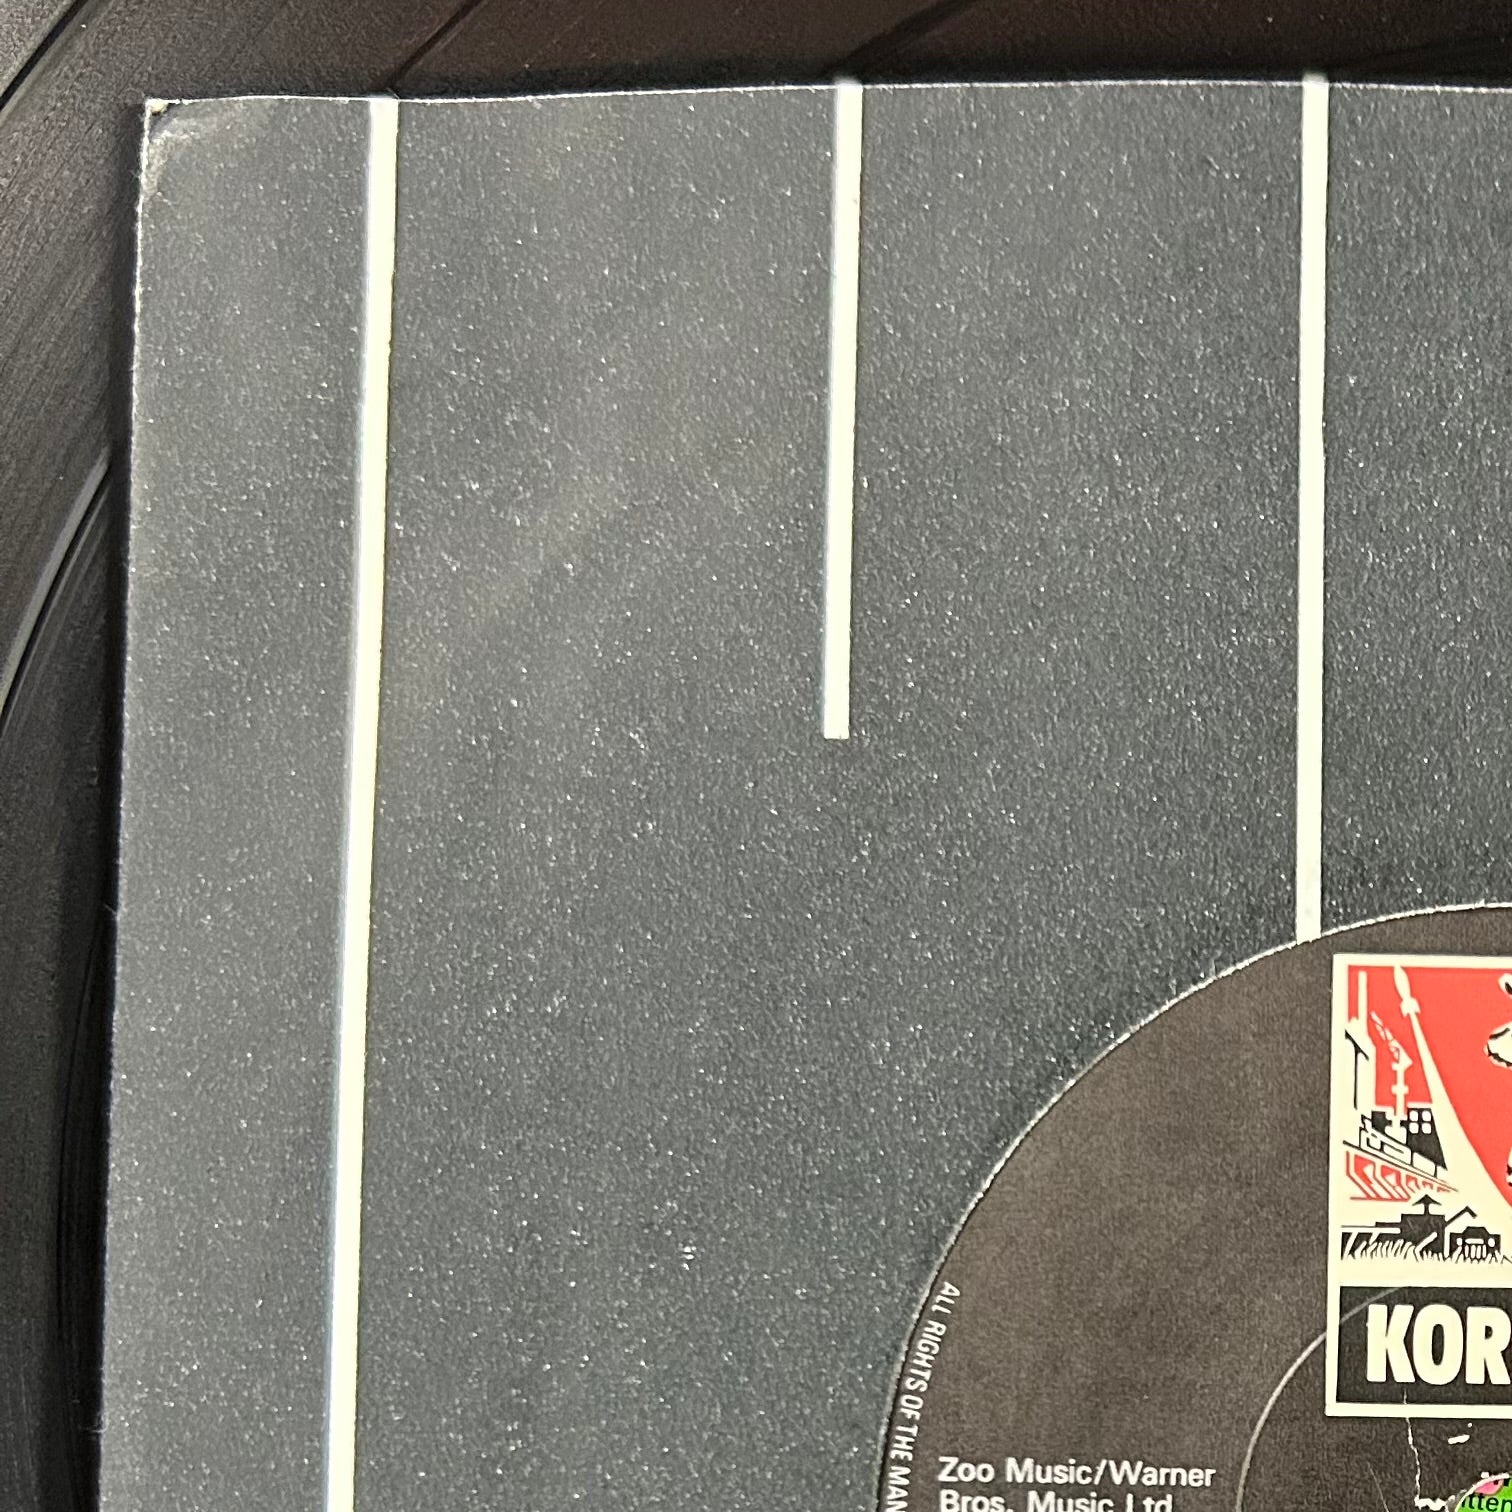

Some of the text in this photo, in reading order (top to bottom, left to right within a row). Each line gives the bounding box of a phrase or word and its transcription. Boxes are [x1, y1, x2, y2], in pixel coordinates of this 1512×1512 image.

[931, 1281, 960, 1314] ALL
[905, 1319, 947, 1393] RIGHTS
[900, 1395, 924, 1421] OF
[890, 1424, 919, 1462] THE
[938, 1456, 1216, 1488] Zoo Music/Warner
